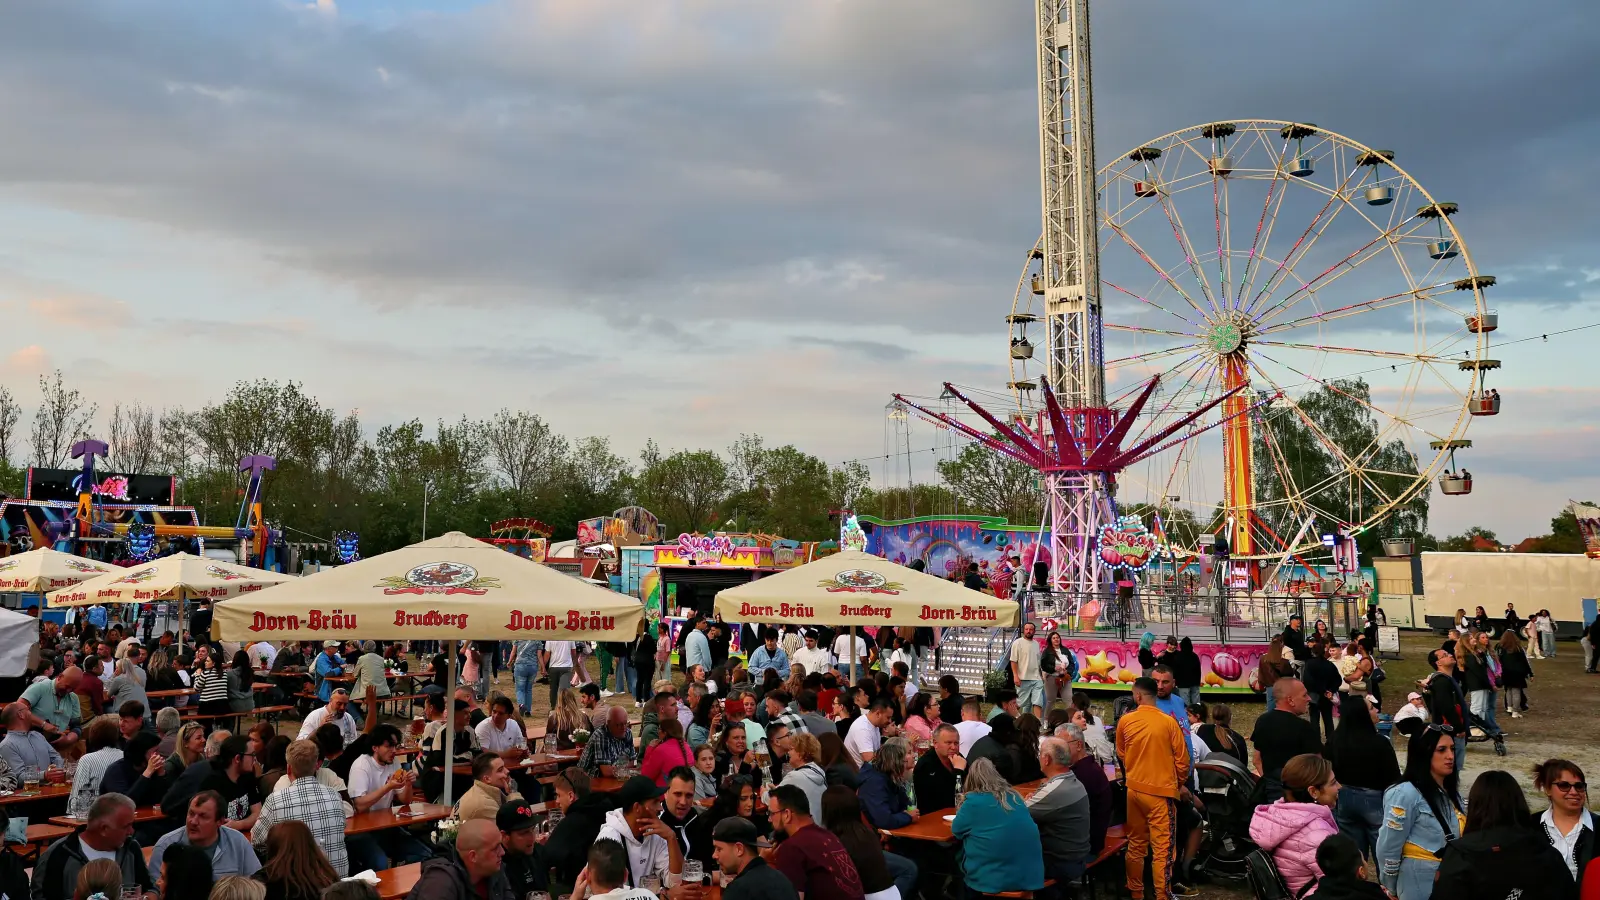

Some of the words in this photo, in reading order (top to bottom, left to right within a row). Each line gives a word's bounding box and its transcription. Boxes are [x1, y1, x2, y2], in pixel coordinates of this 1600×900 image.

[677, 533, 736, 558] Sugar
[1102, 527, 1156, 551] Sugar
[248, 608, 358, 631] Dorn-Bräu
[394, 608, 468, 629] Bruckberg
[506, 609, 615, 631] Dorn-Bräu
[739, 602, 815, 617] Dorn-Bräu
[839, 604, 892, 618] Bruckberg
[919, 605, 997, 620] Dorn-Bräu
